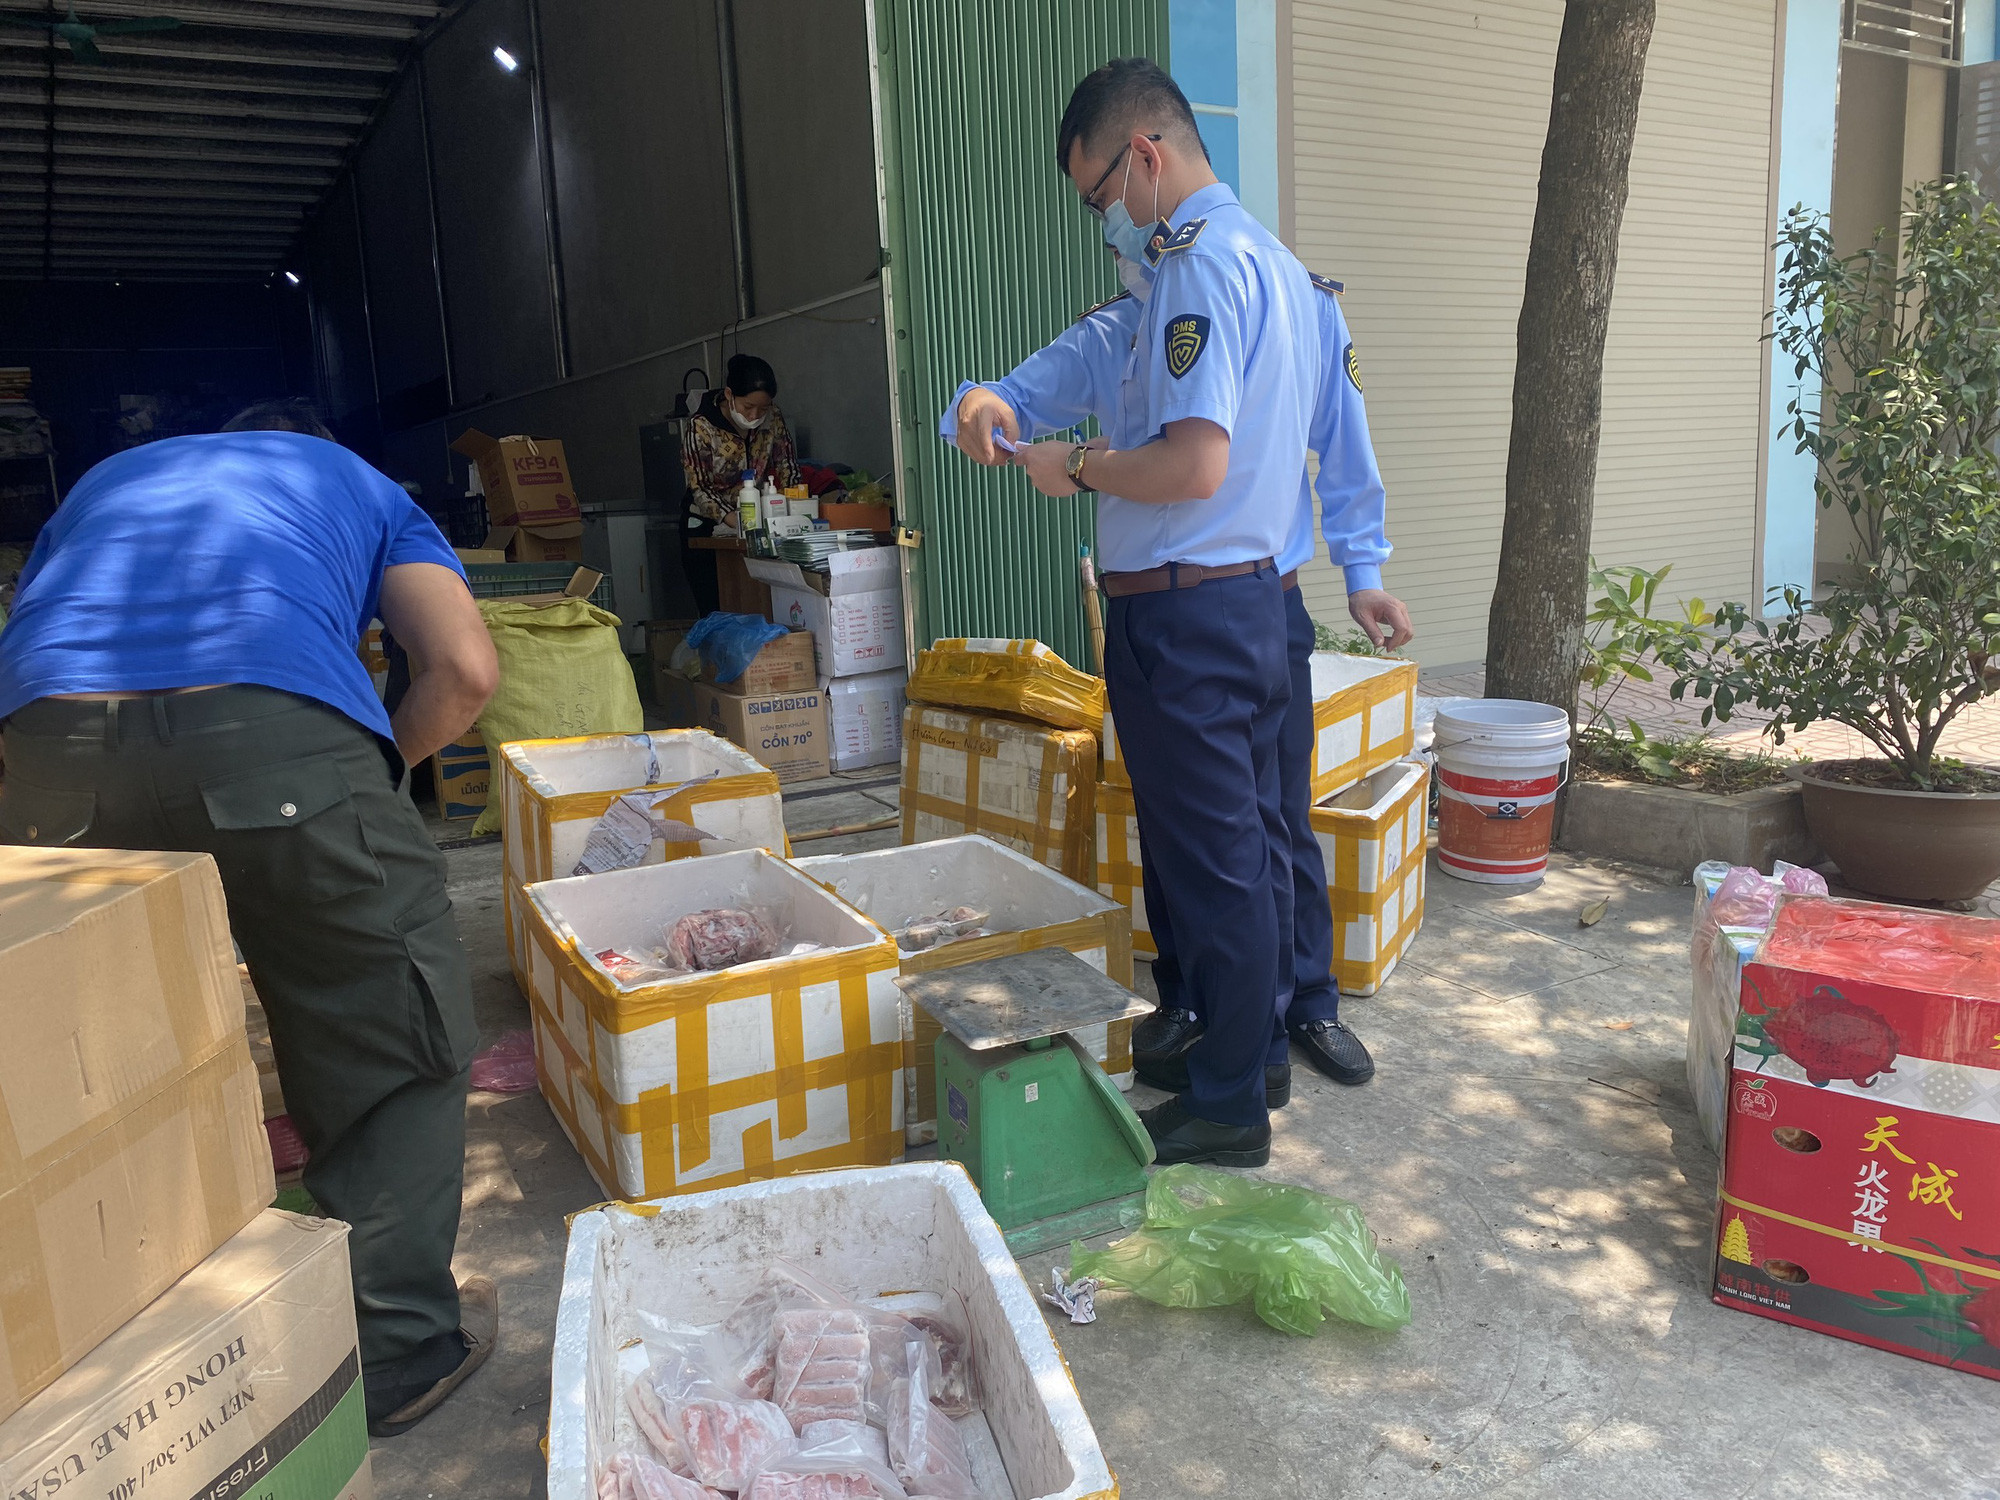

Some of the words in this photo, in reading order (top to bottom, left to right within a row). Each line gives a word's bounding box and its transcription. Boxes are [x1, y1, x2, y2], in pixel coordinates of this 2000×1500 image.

[1173, 320, 1197, 335] DMS
[512, 455, 560, 471] KF94
[761, 732, 790, 749] CỒN
[1858, 1116, 1962, 1221] 天成
[1848, 1160, 1891, 1254] 火龙果
[1717, 1283, 1738, 1295] THANH
[1739, 1291, 1757, 1300] LONG
[1759, 1296, 1773, 1305] VIET
[1775, 1301, 1791, 1310] NAM
[164, 1335, 248, 1409] HONG
[219, 1384, 256, 1425] NET
[90, 1399, 159, 1462] HAE
[179, 1418, 217, 1453] WT.
